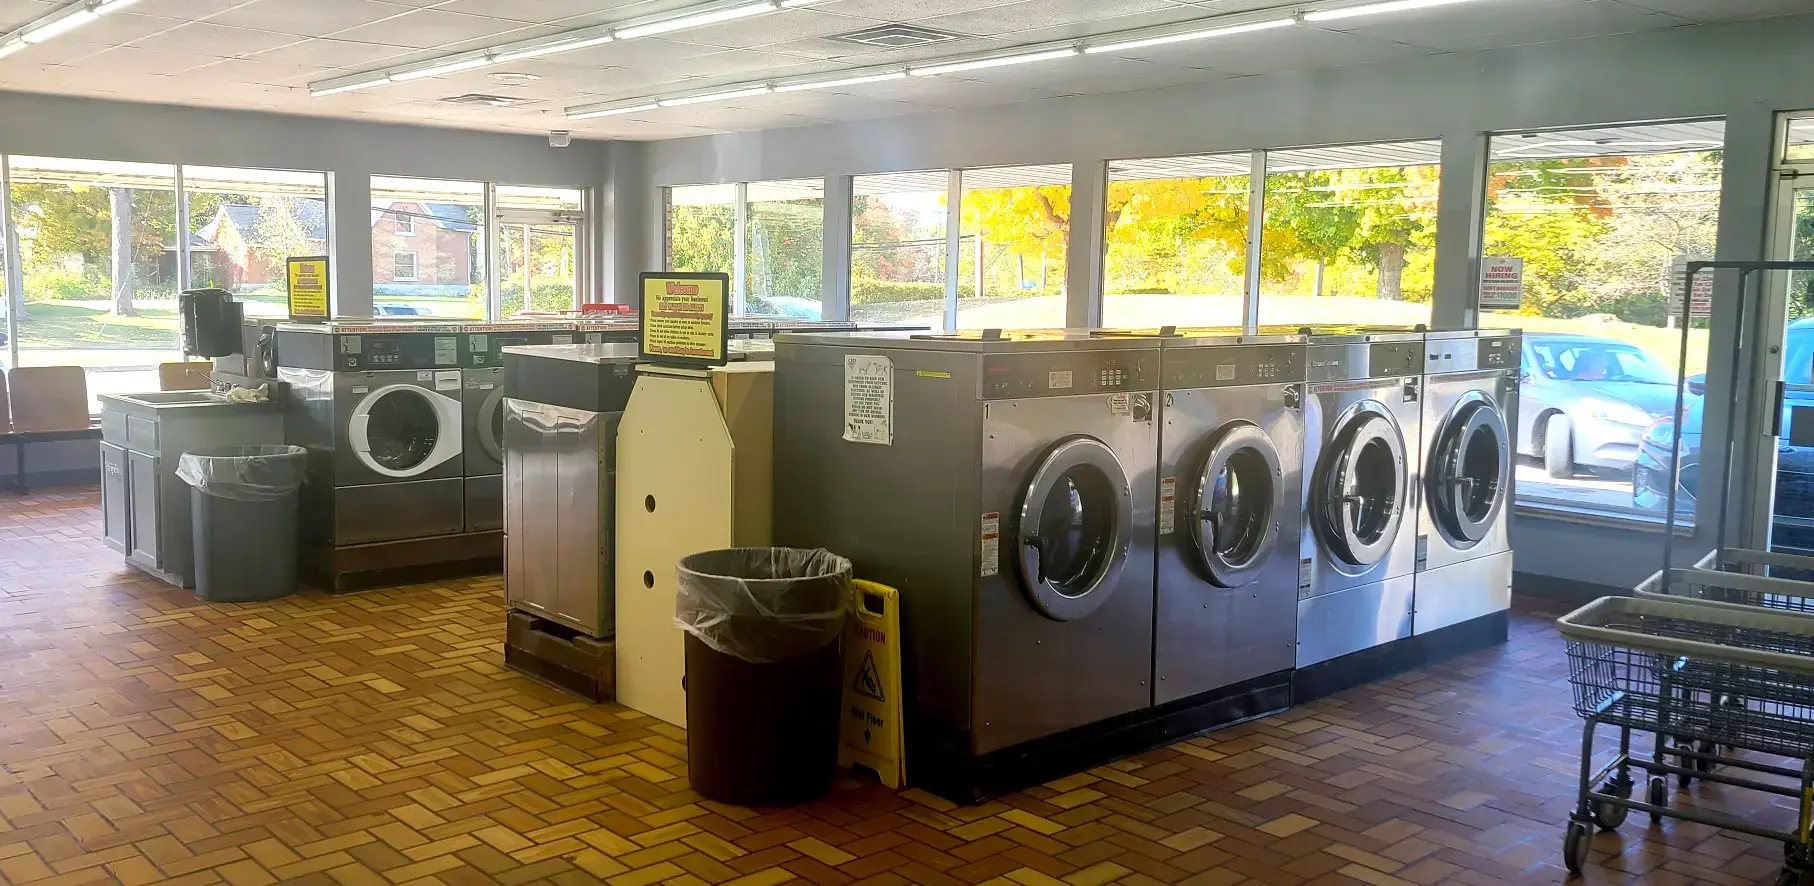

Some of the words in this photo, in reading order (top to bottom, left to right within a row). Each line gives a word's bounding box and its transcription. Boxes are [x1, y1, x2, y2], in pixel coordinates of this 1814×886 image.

[666, 281, 699, 296] Welcome
[985, 403, 989, 419] 1
[867, 711, 884, 728] Floor
